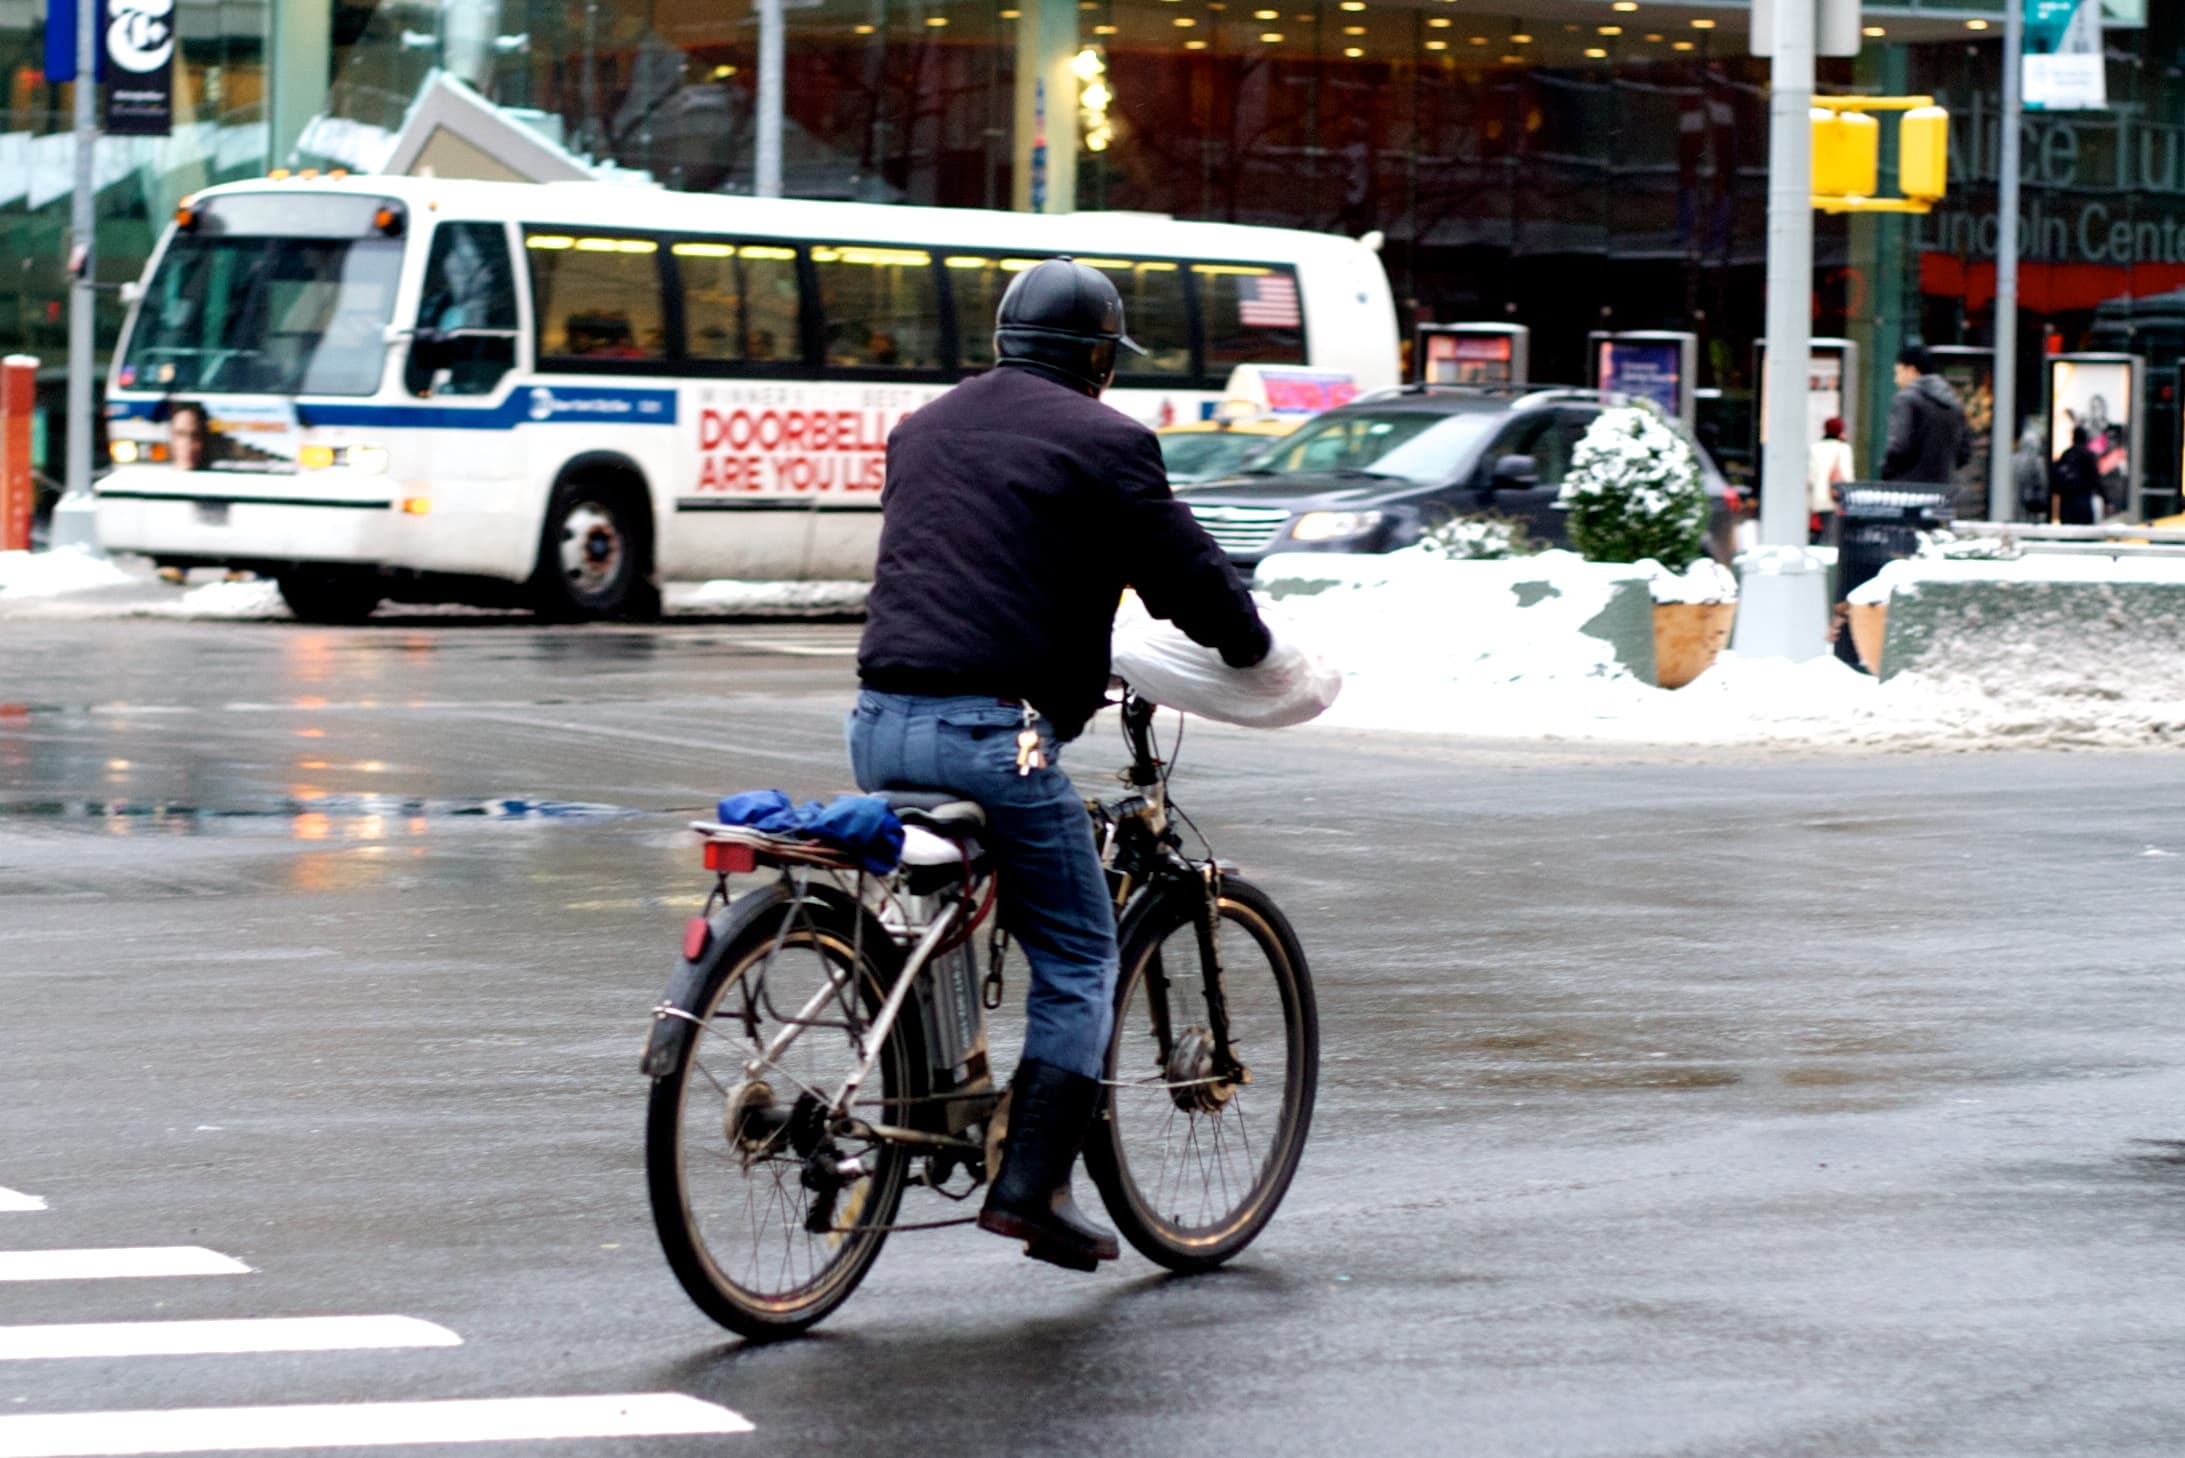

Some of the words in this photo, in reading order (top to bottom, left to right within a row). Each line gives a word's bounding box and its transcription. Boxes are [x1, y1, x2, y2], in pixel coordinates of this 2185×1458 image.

[701, 409, 912, 451] DOORBELL
[698, 456, 761, 491] ARE
[773, 456, 836, 491] YOU
